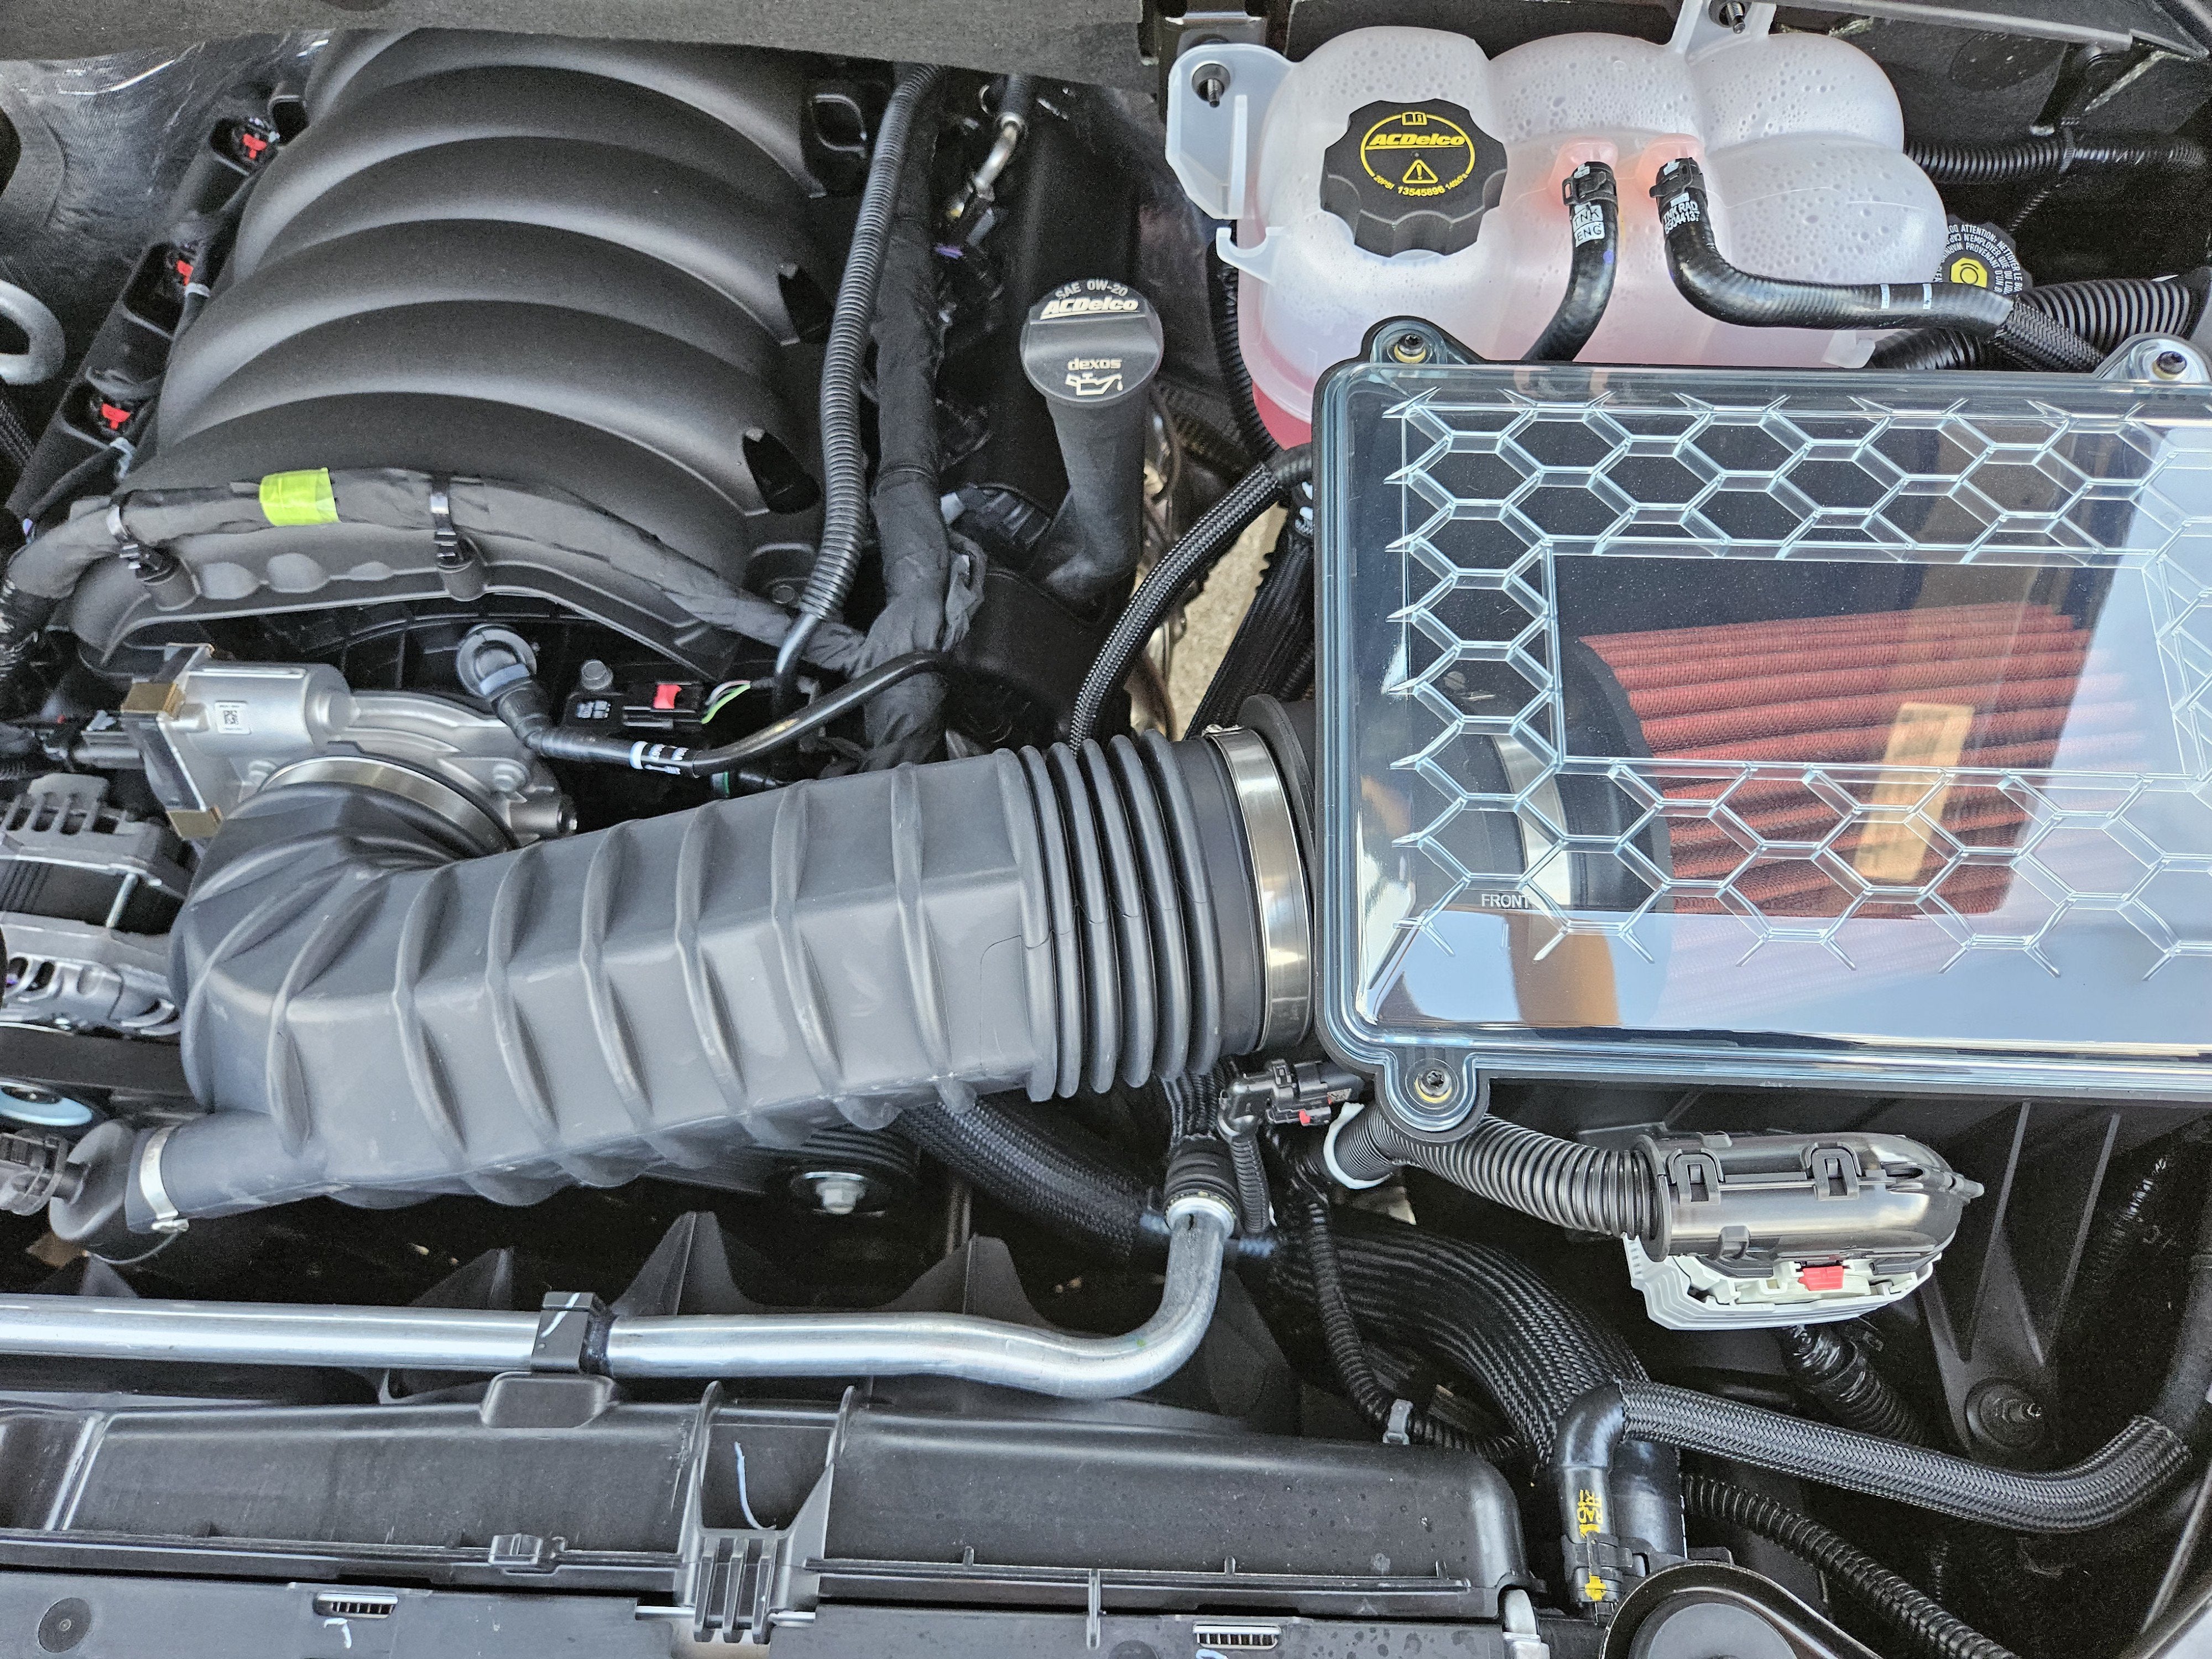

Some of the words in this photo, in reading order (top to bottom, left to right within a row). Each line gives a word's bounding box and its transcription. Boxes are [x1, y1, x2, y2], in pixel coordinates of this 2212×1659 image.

[1369, 133, 1465, 146] ACDelco
[1374, 175, 1395, 190] 20PSI
[1663, 205, 1678, 223] TNK
[1678, 200, 1698, 213] RAD
[1577, 225, 1602, 242] ENG
[1949, 233, 1962, 243] CAP
[1961, 224, 1997, 243] ATTENTION:
[1996, 241, 2021, 272] NETTOYER
[2013, 273, 2023, 281] LE
[1965, 242, 2000, 268] PROVENANT
[1998, 256, 2010, 269] QUE
[2004, 270, 2013, 279] DU
[1055, 283, 1082, 299] SAE
[1087, 279, 1128, 297] 0W-20
[1041, 295, 1139, 316] ACDelco
[1068, 357, 1123, 371] dexos
[1481, 894, 1530, 909] FRONT
[1577, 1507, 1603, 1525] RAD
